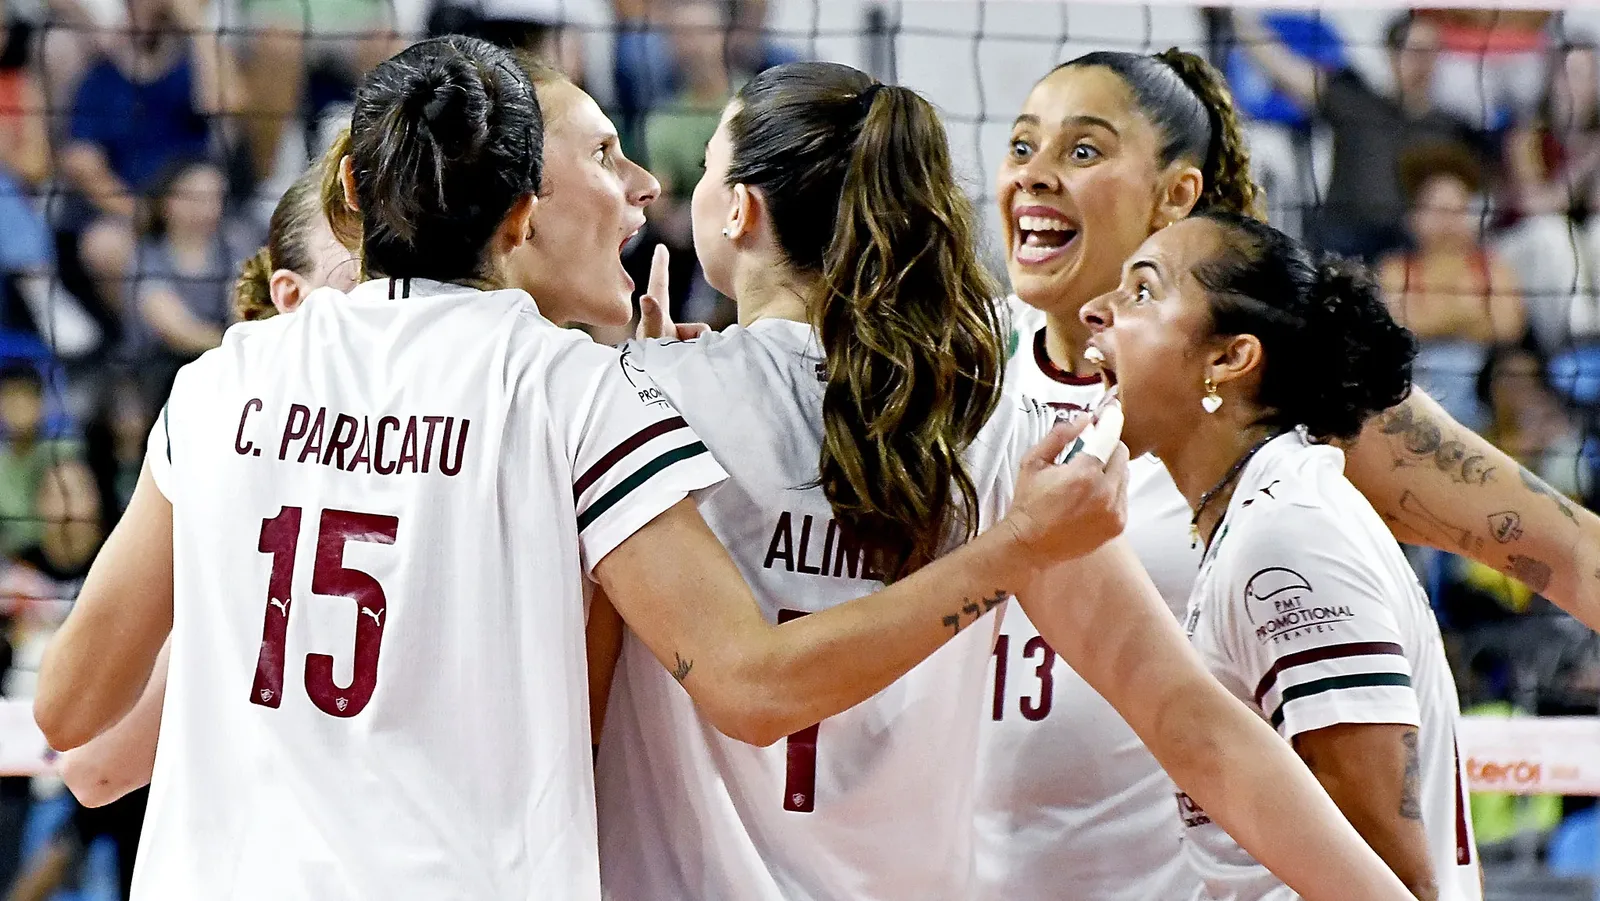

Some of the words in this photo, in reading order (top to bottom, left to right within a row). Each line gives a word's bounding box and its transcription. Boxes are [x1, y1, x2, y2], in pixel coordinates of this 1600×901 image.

[234, 398, 262, 457] C.
[278, 403, 470, 477] PARACATU
[249, 505, 399, 718] 15
[1255, 605, 1355, 641] PROMOTIONAL
[1274, 596, 1302, 612] PMT
[1274, 624, 1334, 644] TRAVEL
[992, 633, 1056, 722] 13
